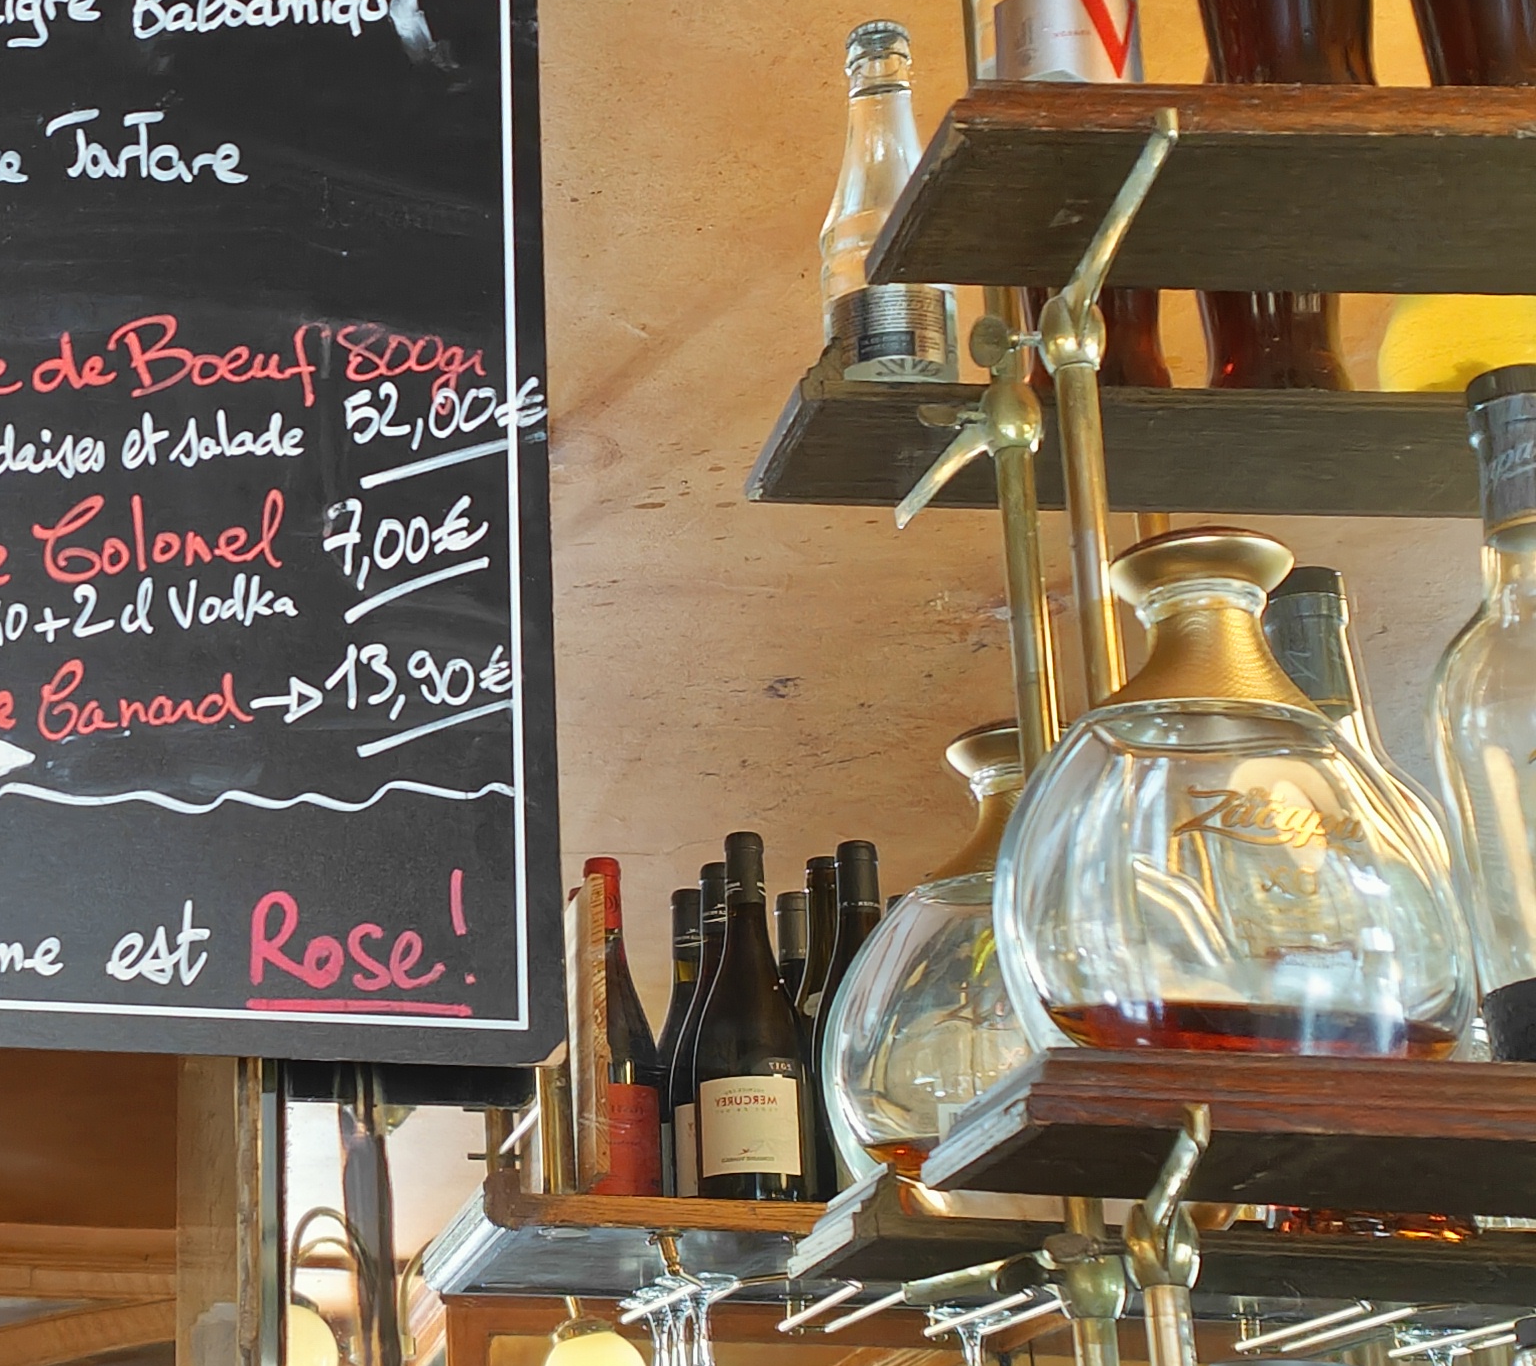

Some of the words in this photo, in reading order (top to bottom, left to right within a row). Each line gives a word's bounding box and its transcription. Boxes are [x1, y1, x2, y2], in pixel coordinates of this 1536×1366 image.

[30, 330, 118, 394] de
[106, 312, 332, 409] Boeuf
[120, 410, 170, 472] et
[168, 408, 306, 469] salade
[166, 572, 300, 630] Vodka
[105, 898, 212, 987] est
